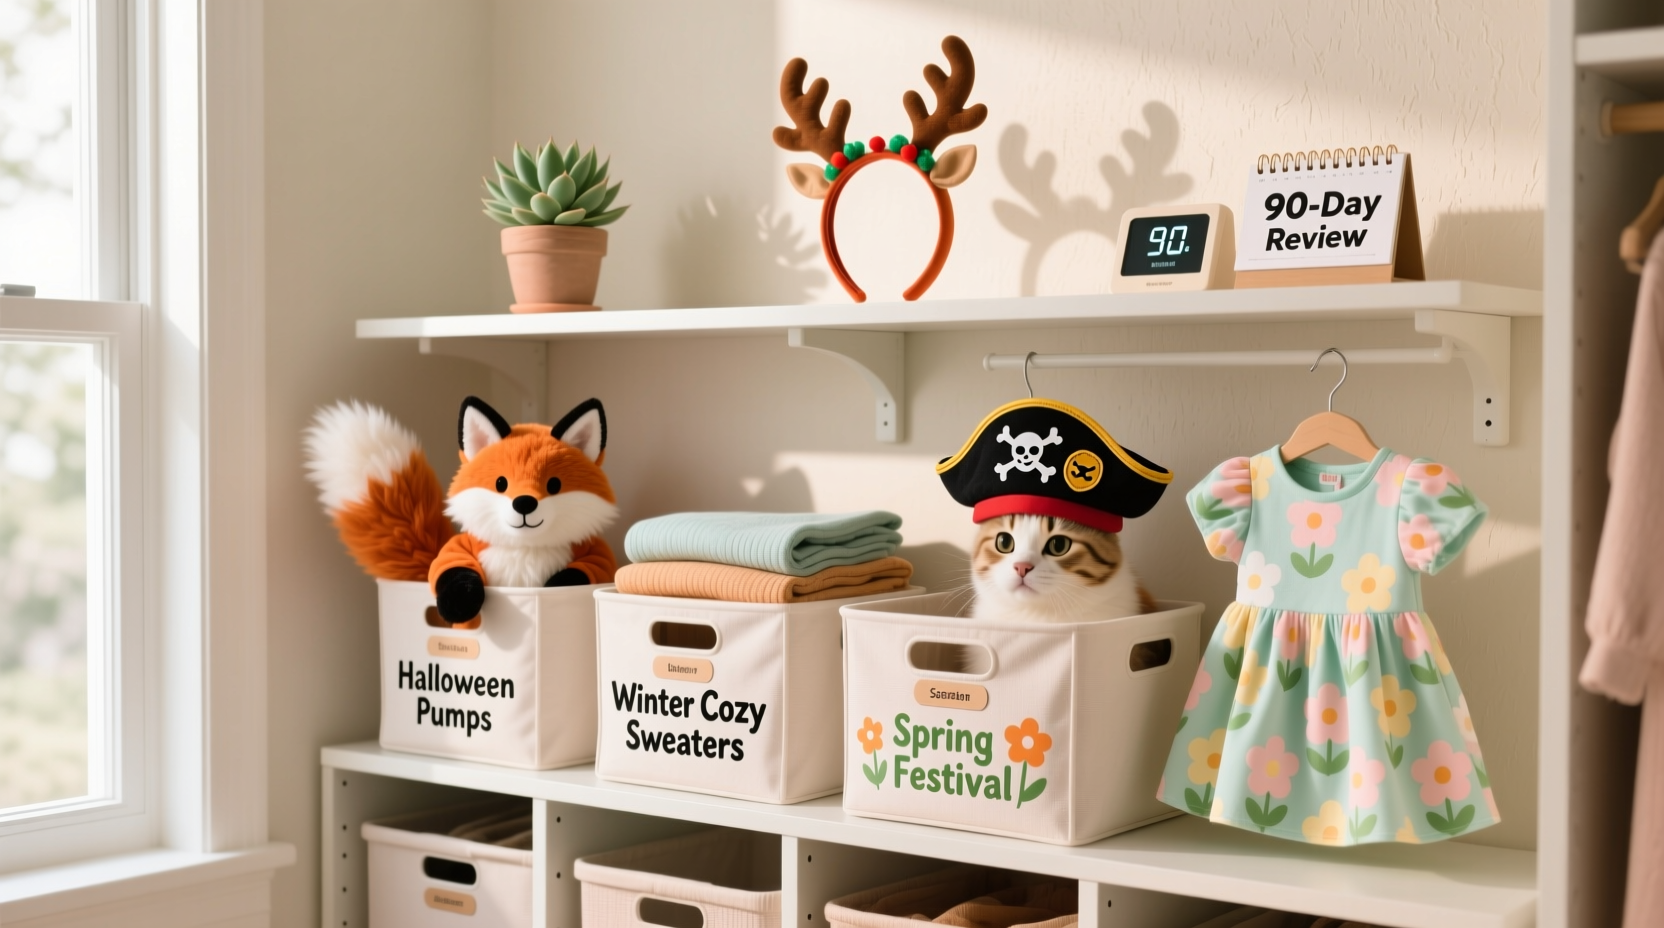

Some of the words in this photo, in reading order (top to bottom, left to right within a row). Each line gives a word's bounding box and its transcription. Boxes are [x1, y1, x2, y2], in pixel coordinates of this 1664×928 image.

[1264, 191, 1382, 221] 90-Day
[1265, 224, 1368, 251] Review
[398, 660, 514, 699] Halloween
[417, 696, 492, 737] Pumps
[611, 680, 695, 718] Winter
[700, 689, 767, 734] Cozy
[625, 719, 744, 761] Sweaters
[893, 712, 993, 767] Spring
[894, 754, 1012, 801] Festival
